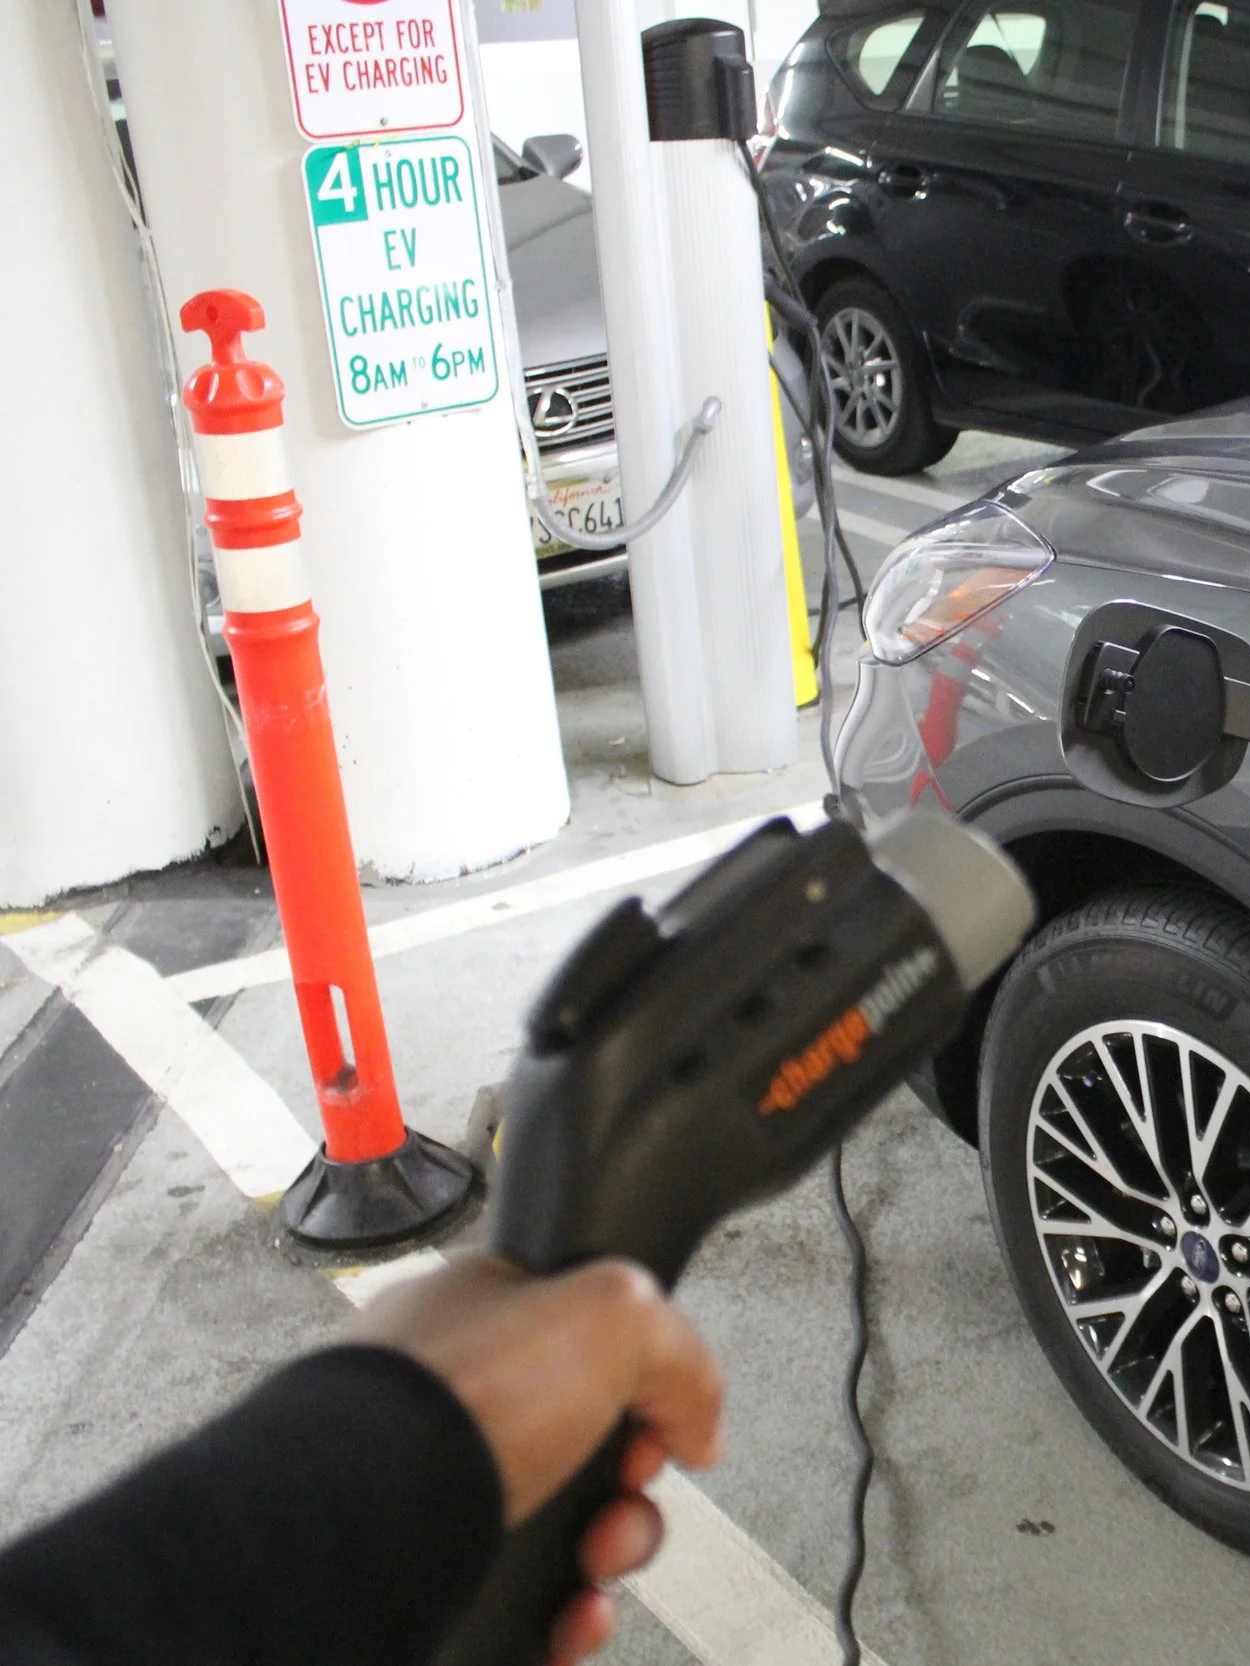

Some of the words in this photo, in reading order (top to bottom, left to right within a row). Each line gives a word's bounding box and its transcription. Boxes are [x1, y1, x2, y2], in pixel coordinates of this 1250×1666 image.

[307, 21, 385, 55] EXCEPT
[396, 19, 436, 50] FOR
[305, 62, 331, 94] EV
[342, 55, 448, 91] CHARGING
[317, 151, 358, 213] 4
[373, 156, 463, 211] HOUR
[383, 227, 417, 271] EV
[339, 279, 479, 337] CHARGING
[349, 354, 408, 394] 8AM
[412, 357, 426, 369] TO
[431, 342, 486, 381] 6PM
